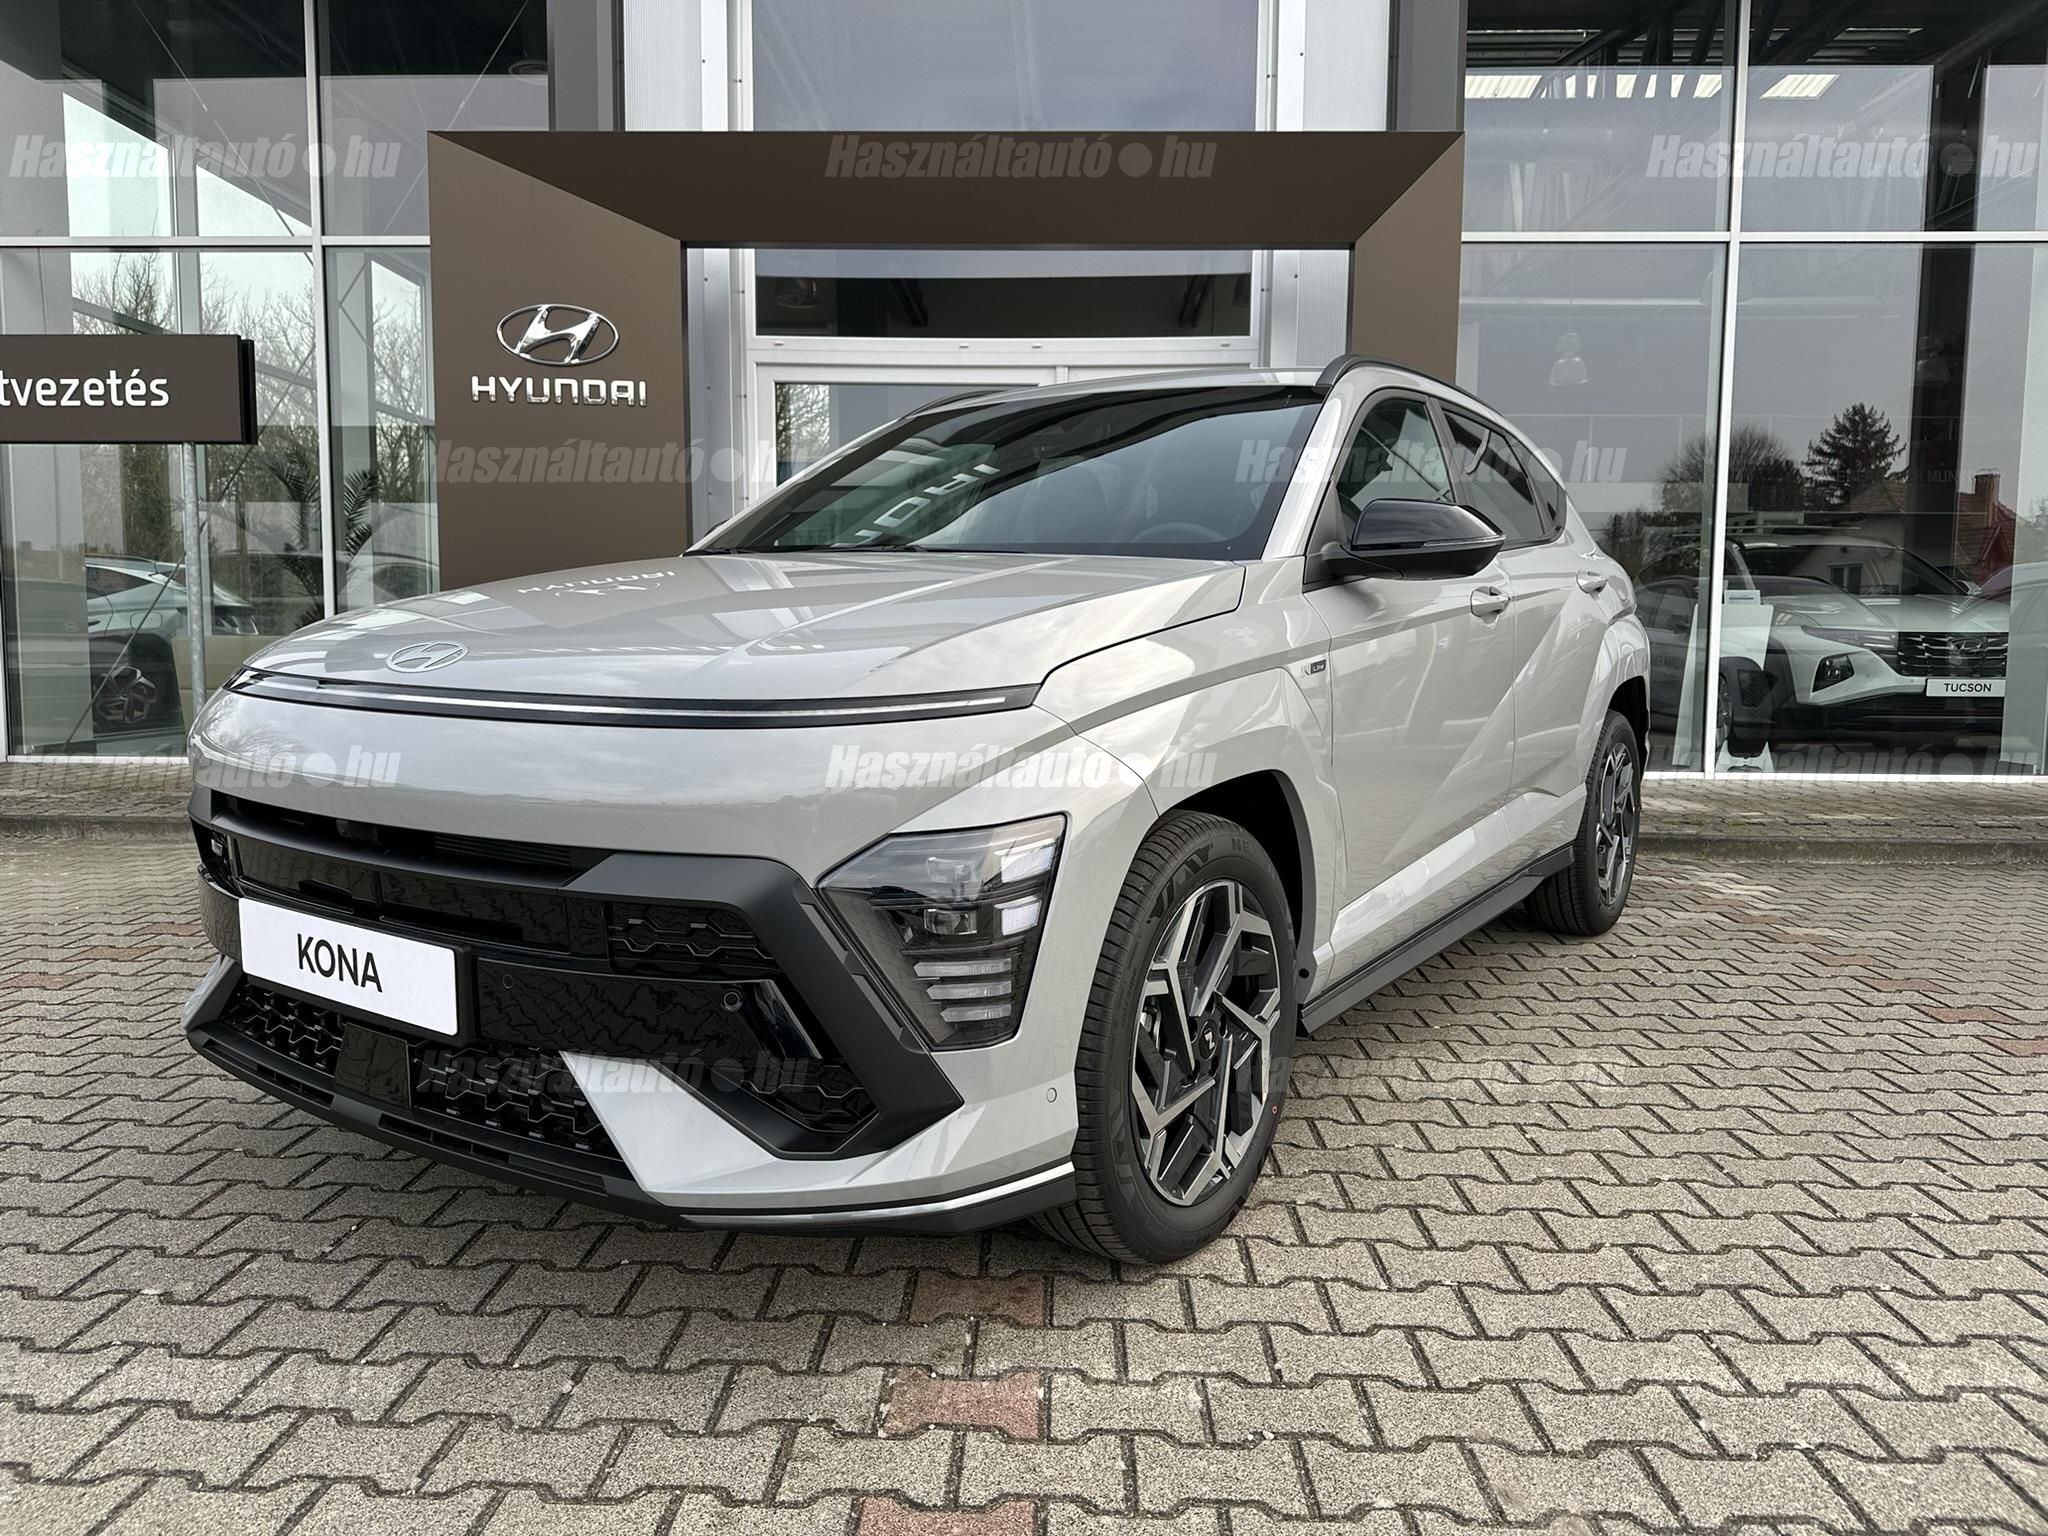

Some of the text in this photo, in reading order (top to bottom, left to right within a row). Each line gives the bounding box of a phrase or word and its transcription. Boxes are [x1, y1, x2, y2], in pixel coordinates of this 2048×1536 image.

[0, 368, 170, 407] tvezetés
[471, 375, 648, 407] HYUNDAI
[1943, 682, 1992, 693] TUCSON
[297, 933, 383, 993] KONA
